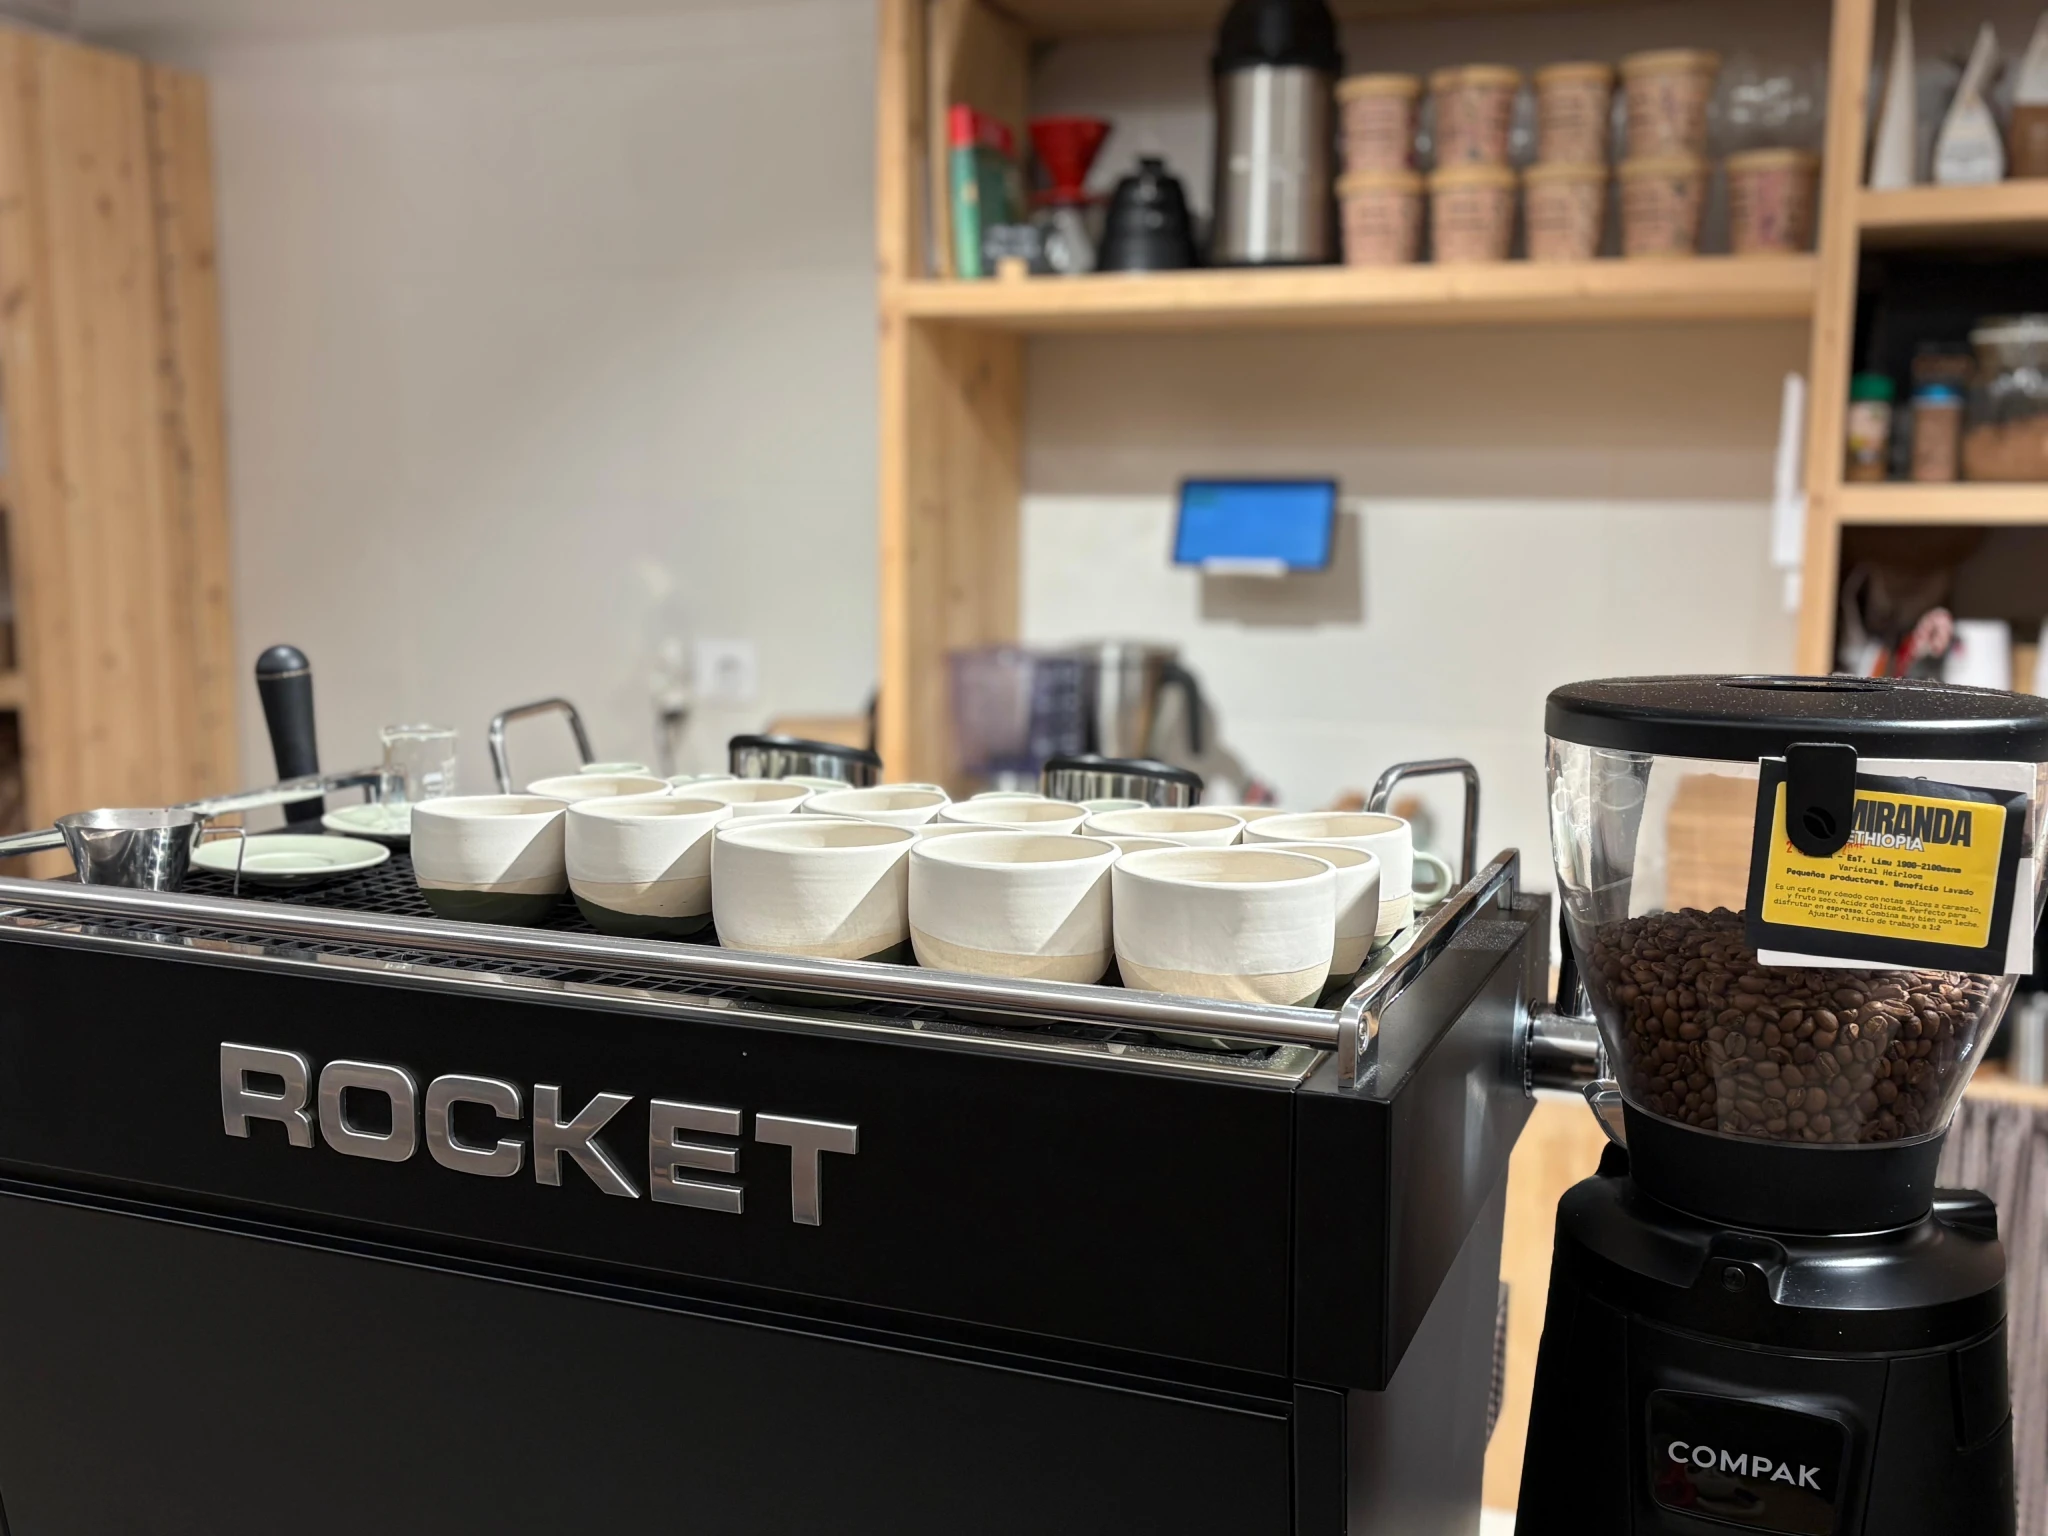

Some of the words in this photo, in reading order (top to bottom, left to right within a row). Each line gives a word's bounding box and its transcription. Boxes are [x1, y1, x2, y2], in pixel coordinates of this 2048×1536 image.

[1839, 864, 1878, 874] Varietal
[1883, 869, 1923, 879] Heirloom
[1872, 857, 1892, 866] Limu
[1786, 867, 1826, 879] Pequeños
[1830, 874, 1888, 886] productores.
[1894, 880, 1939, 892] Beneficio
[1943, 886, 1974, 896] Lavado
[1795, 892, 1816, 901] fruto
[1840, 898, 1867, 908] Acidez
[1870, 902, 1907, 912] delicada.
[1909, 906, 1946, 916] Perfecto
[1818, 889, 1831, 897] muy
[1834, 890, 1862, 899] cómodo
[1881, 897, 1903, 905] notas
[1905, 899, 1933, 907] dulces
[1773, 898, 1812, 908] disfrutar
[1826, 905, 1864, 914] espresso.
[1866, 909, 1899, 919] Combina
[1917, 914, 1937, 923] bien
[1955, 919, 1979, 928] leche.
[1808, 909, 1838, 919] Ajustar
[1852, 915, 1874, 923] ratio
[1877, 917, 1887, 925] de
[1889, 919, 1919, 929] trabajo
[220, 1041, 859, 1227] ROCKET
[1667, 1440, 1822, 1491] COMPAK
